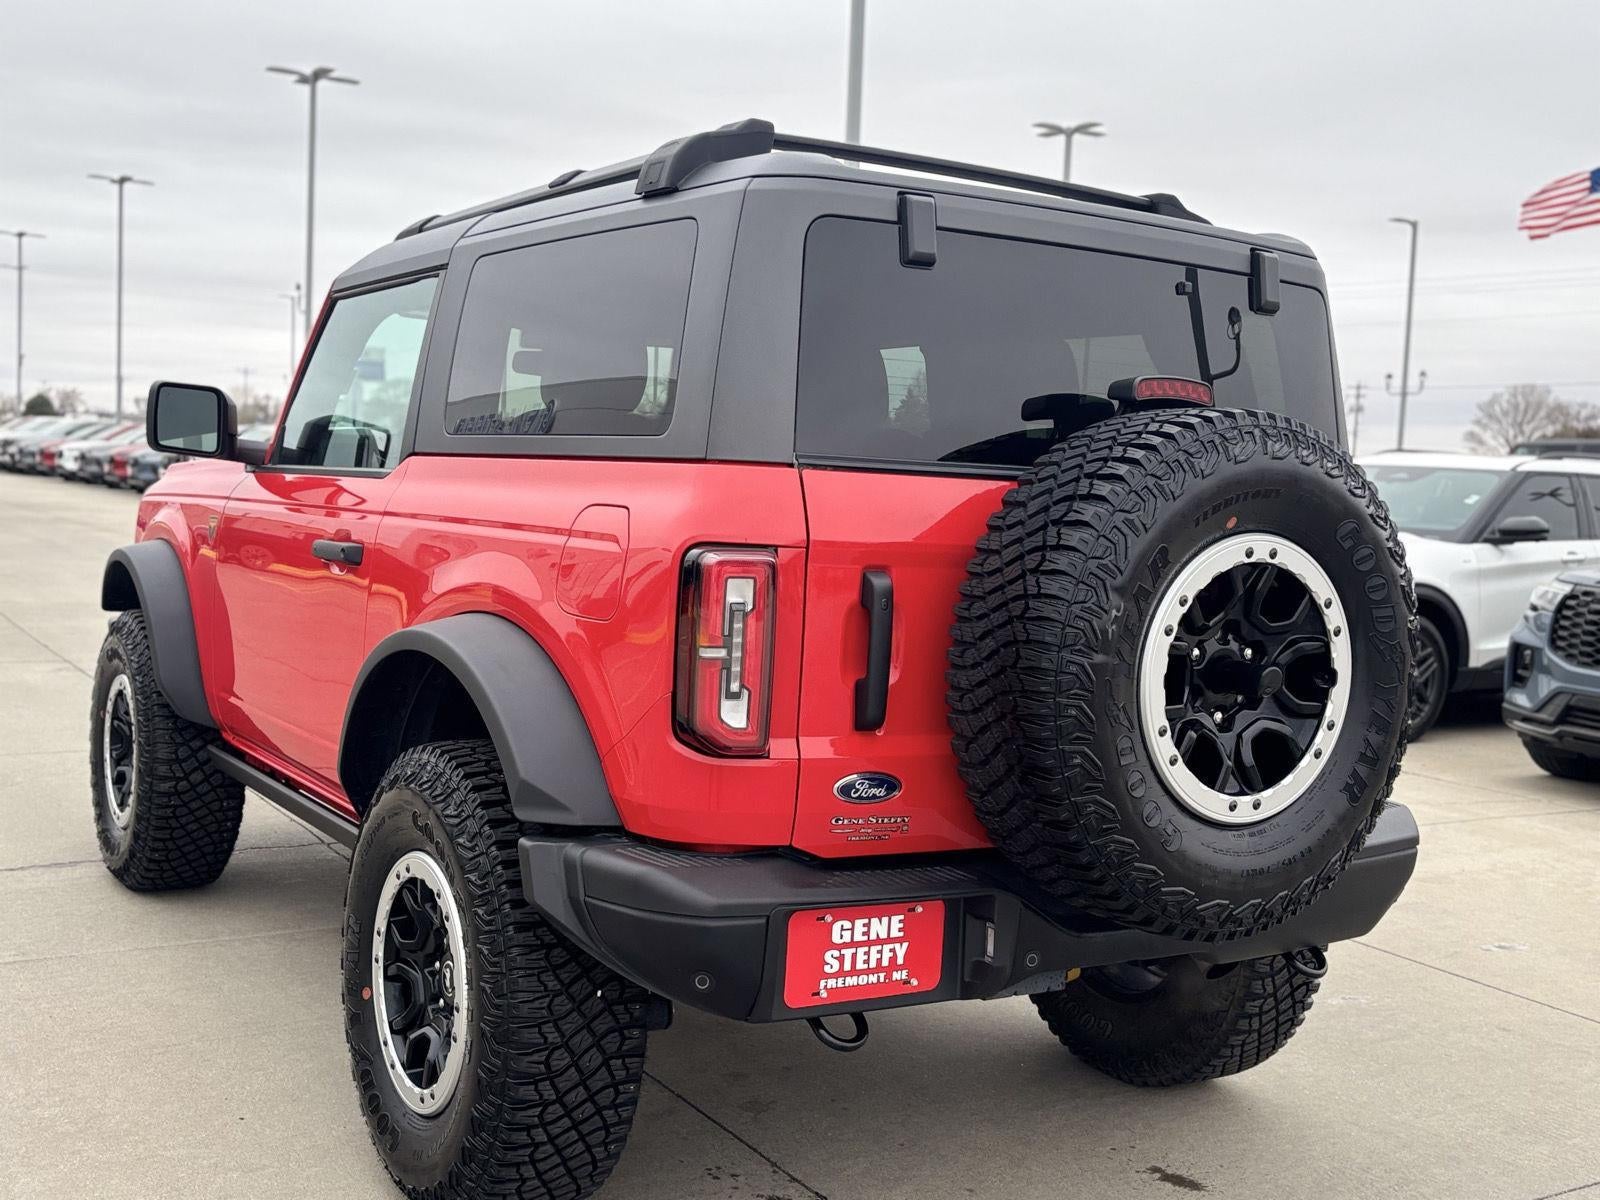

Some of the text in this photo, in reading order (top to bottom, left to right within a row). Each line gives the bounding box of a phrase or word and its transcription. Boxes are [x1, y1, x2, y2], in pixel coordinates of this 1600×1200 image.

[1335, 518, 1404, 809] GOODYEAR
[850, 778, 888, 798] Ford
[831, 914, 906, 945] GENE
[823, 942, 909, 974] STEFFY
[819, 969, 909, 990] FREMONT, NE
